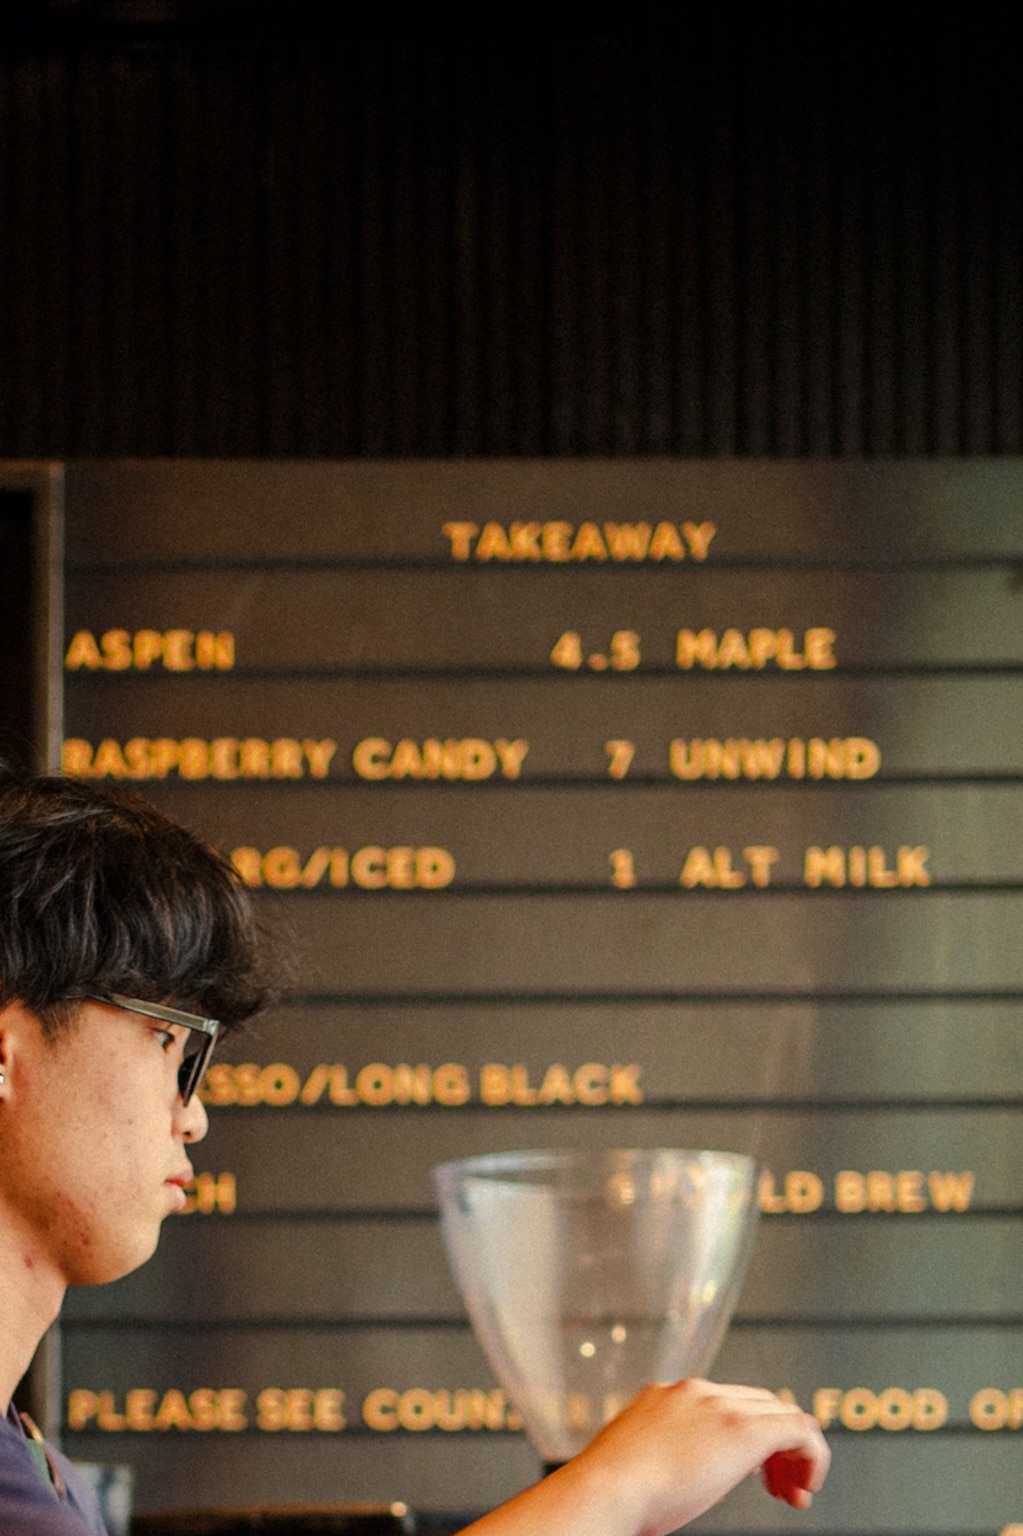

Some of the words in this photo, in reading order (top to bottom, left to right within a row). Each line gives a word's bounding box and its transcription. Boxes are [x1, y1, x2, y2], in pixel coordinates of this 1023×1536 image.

[444, 521, 715, 561] TAKEAWAY
[66, 629, 235, 670] ASPEN
[550, 630, 640, 670] 4.5
[676, 627, 835, 669] MAPLE
[63, 738, 336, 779] RASPBERRY
[353, 738, 528, 779] CANDY
[605, 740, 635, 778] 7
[670, 737, 881, 779] UNWIND
[681, 846, 778, 888] ALT
[804, 847, 930, 887] MILK
[480, 1064, 642, 1105] BLACK
[759, 1171, 824, 1213] LD
[835, 1171, 974, 1212] BREW
[68, 1388, 246, 1431] PLEASE
[256, 1388, 344, 1431] SEE
[809, 1388, 948, 1431] FOOD
